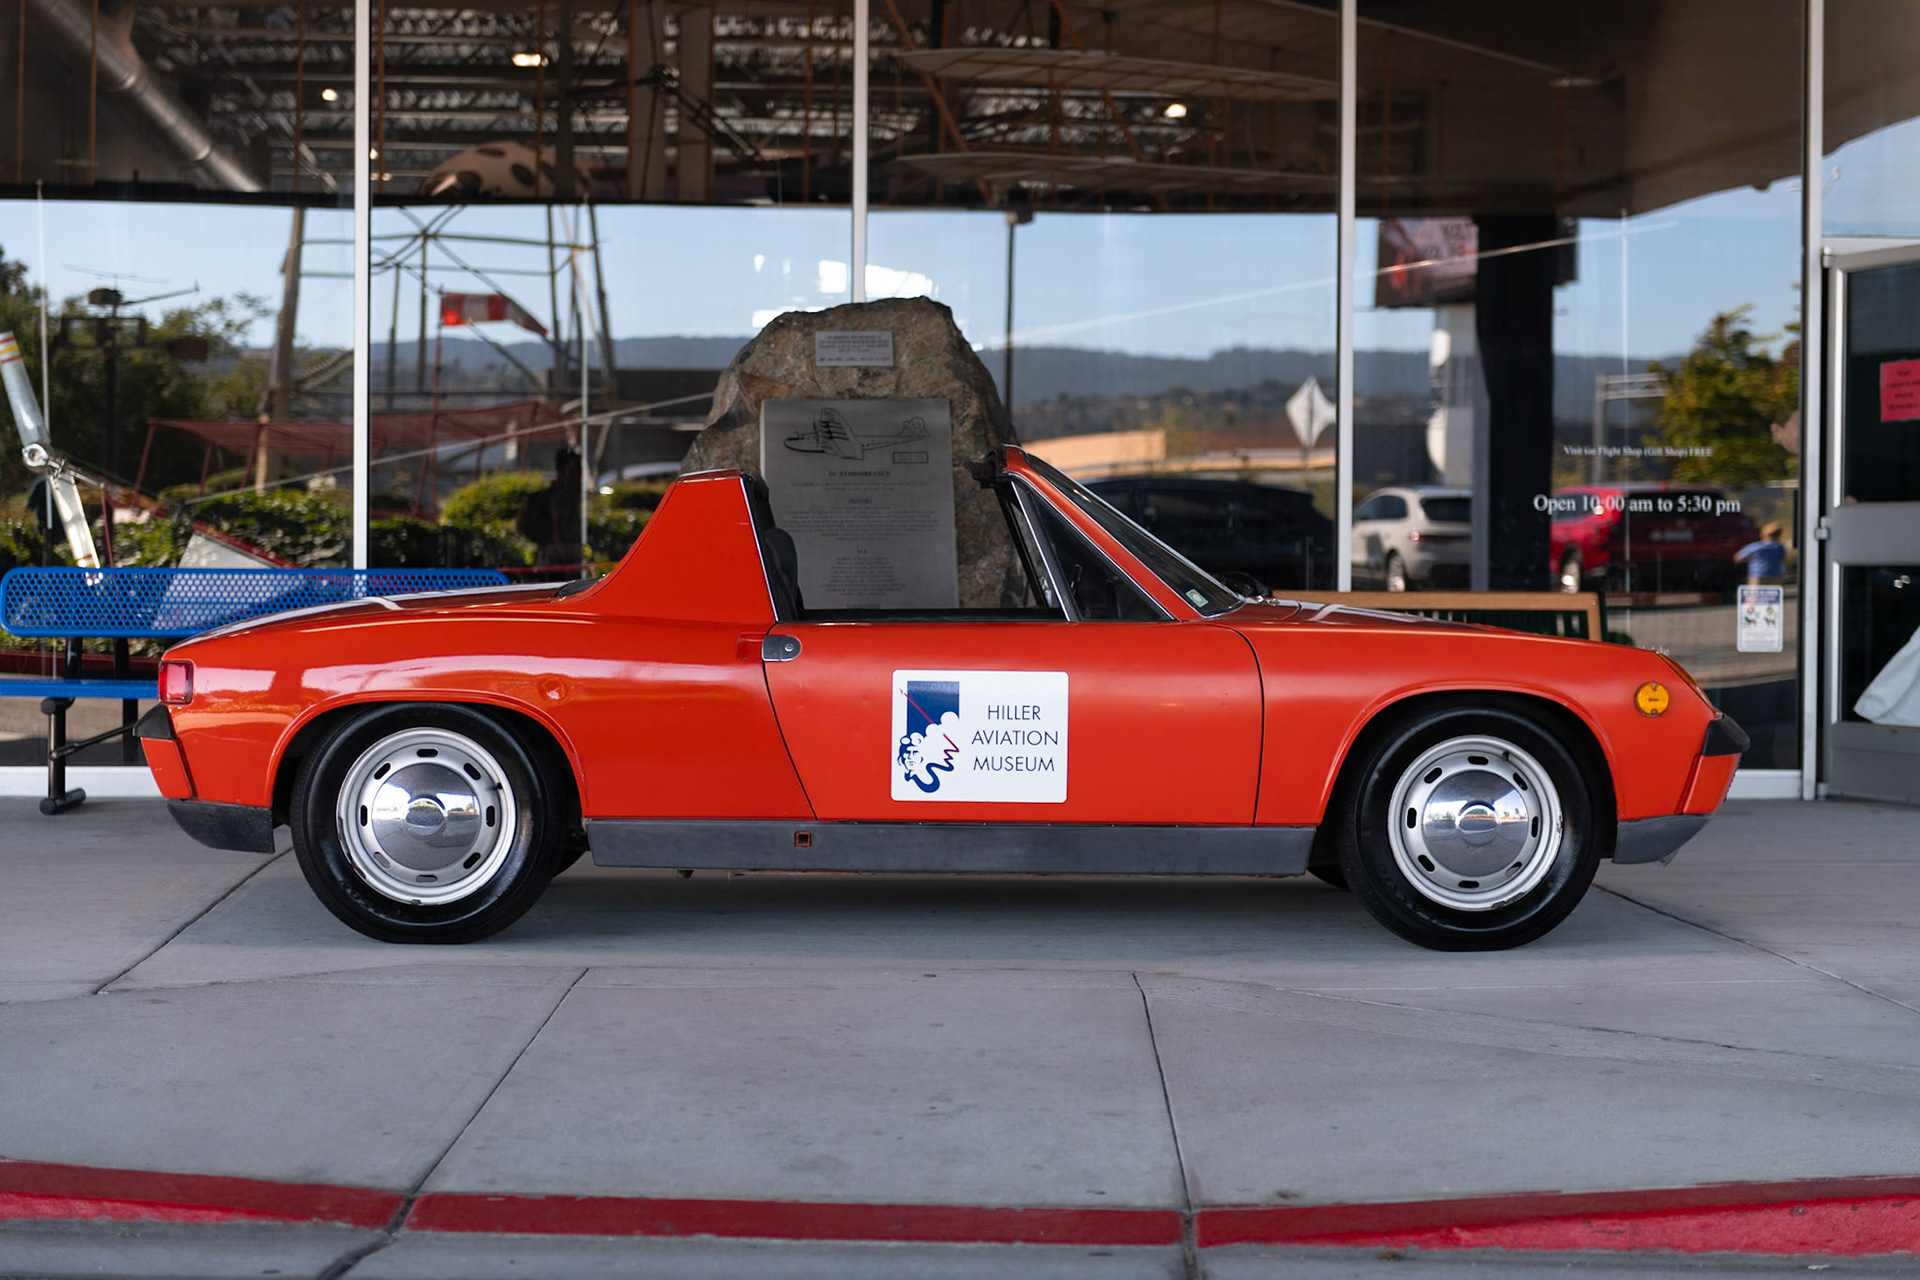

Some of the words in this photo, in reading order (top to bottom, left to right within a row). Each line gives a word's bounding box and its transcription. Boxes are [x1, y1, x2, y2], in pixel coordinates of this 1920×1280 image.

[1564, 446, 1583, 456] Visit
[1598, 445, 1621, 458] Flight
[1623, 446, 1642, 458] Shop
[1644, 446, 1663, 458] (Gift
[1665, 446, 1688, 458] Shop)
[1689, 446, 1713, 457] FREE
[1533, 494, 1576, 515] Open
[1583, 495, 1625, 511] 10:00
[1629, 499, 1653, 512] am
[1657, 496, 1673, 512] to
[1677, 495, 1712, 512] 5:30
[1715, 499, 1741, 516] pm
[988, 705, 1041, 720] HILLER
[971, 730, 1058, 746] AVIATION
[973, 756, 1055, 772] MUSEUM
